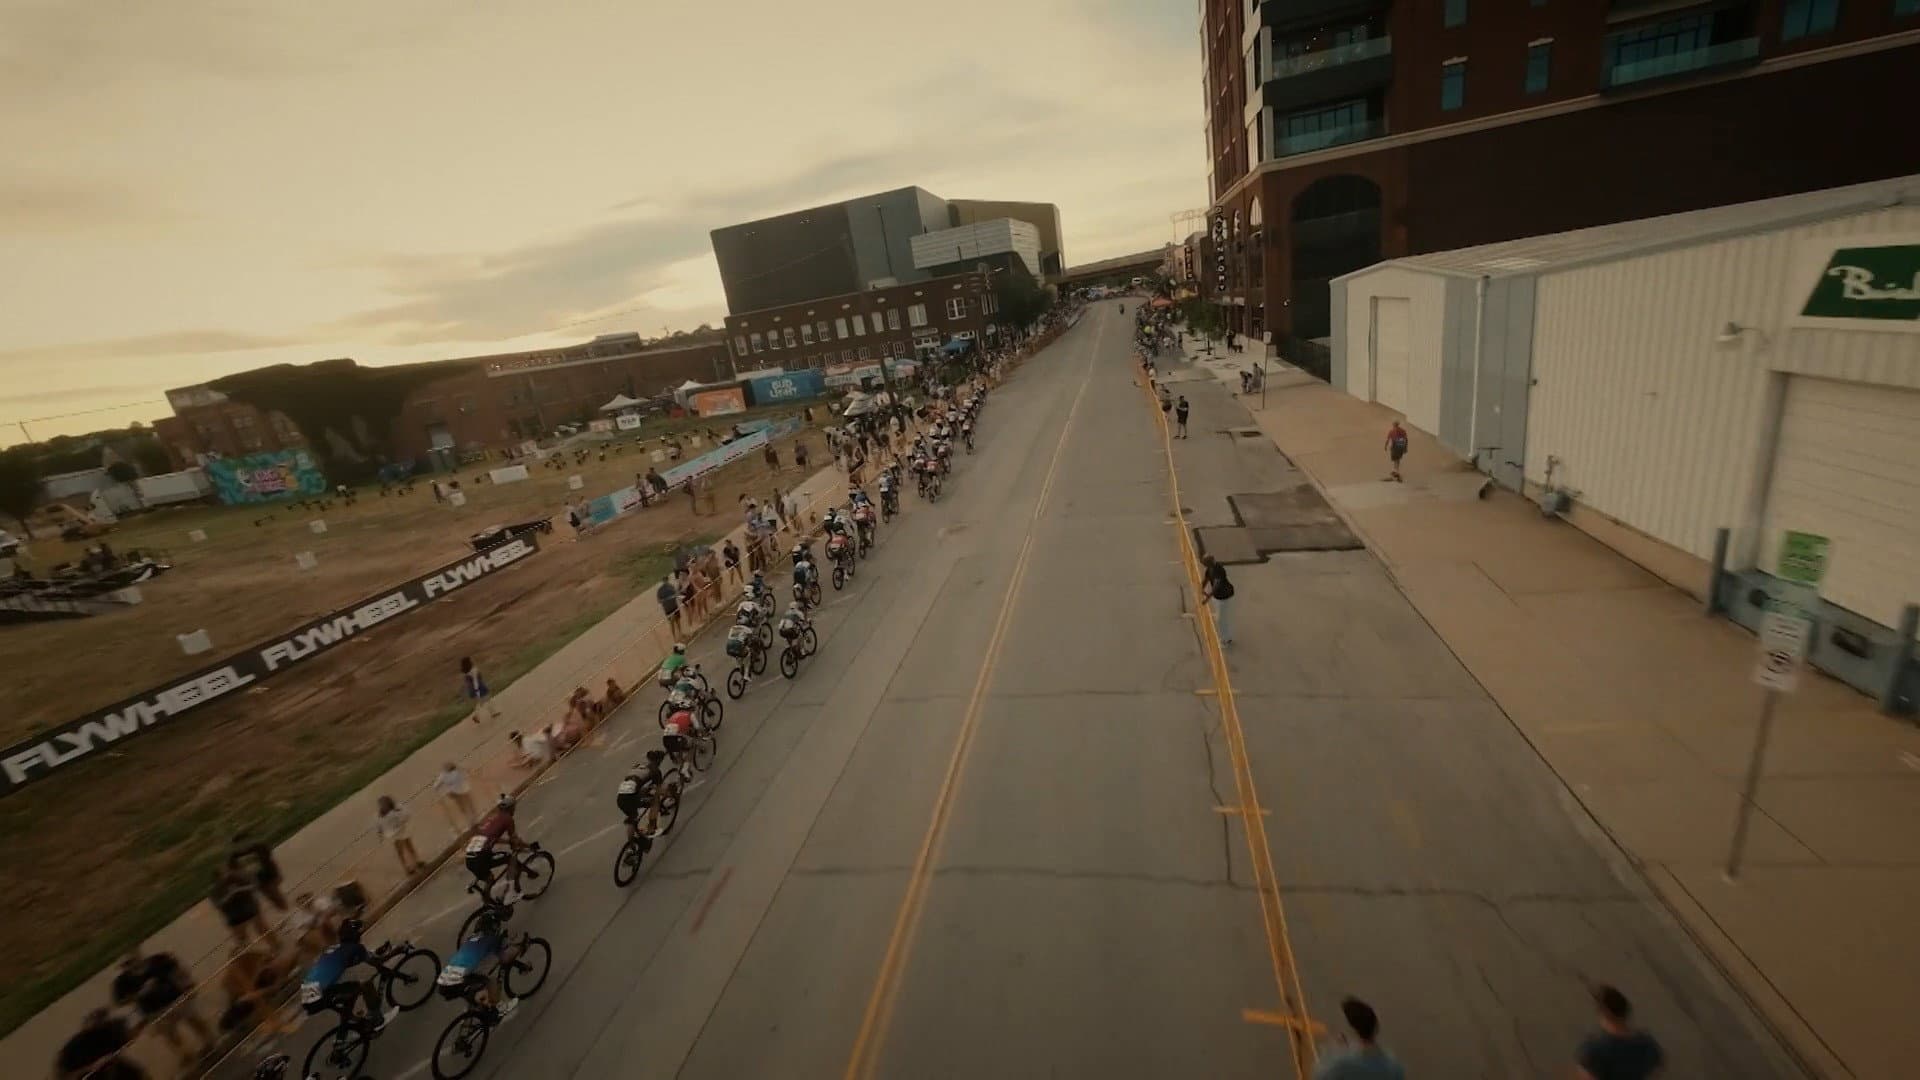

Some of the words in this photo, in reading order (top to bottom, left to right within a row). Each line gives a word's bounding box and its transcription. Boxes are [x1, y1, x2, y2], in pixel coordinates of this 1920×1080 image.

[771, 379, 793, 391] BUD
[769, 386, 798, 399] LIGHT
[2, 666, 255, 784] FLYWHEEL
[261, 590, 419, 672] FLYWHEEL
[422, 538, 536, 599] FLYWHEEL
